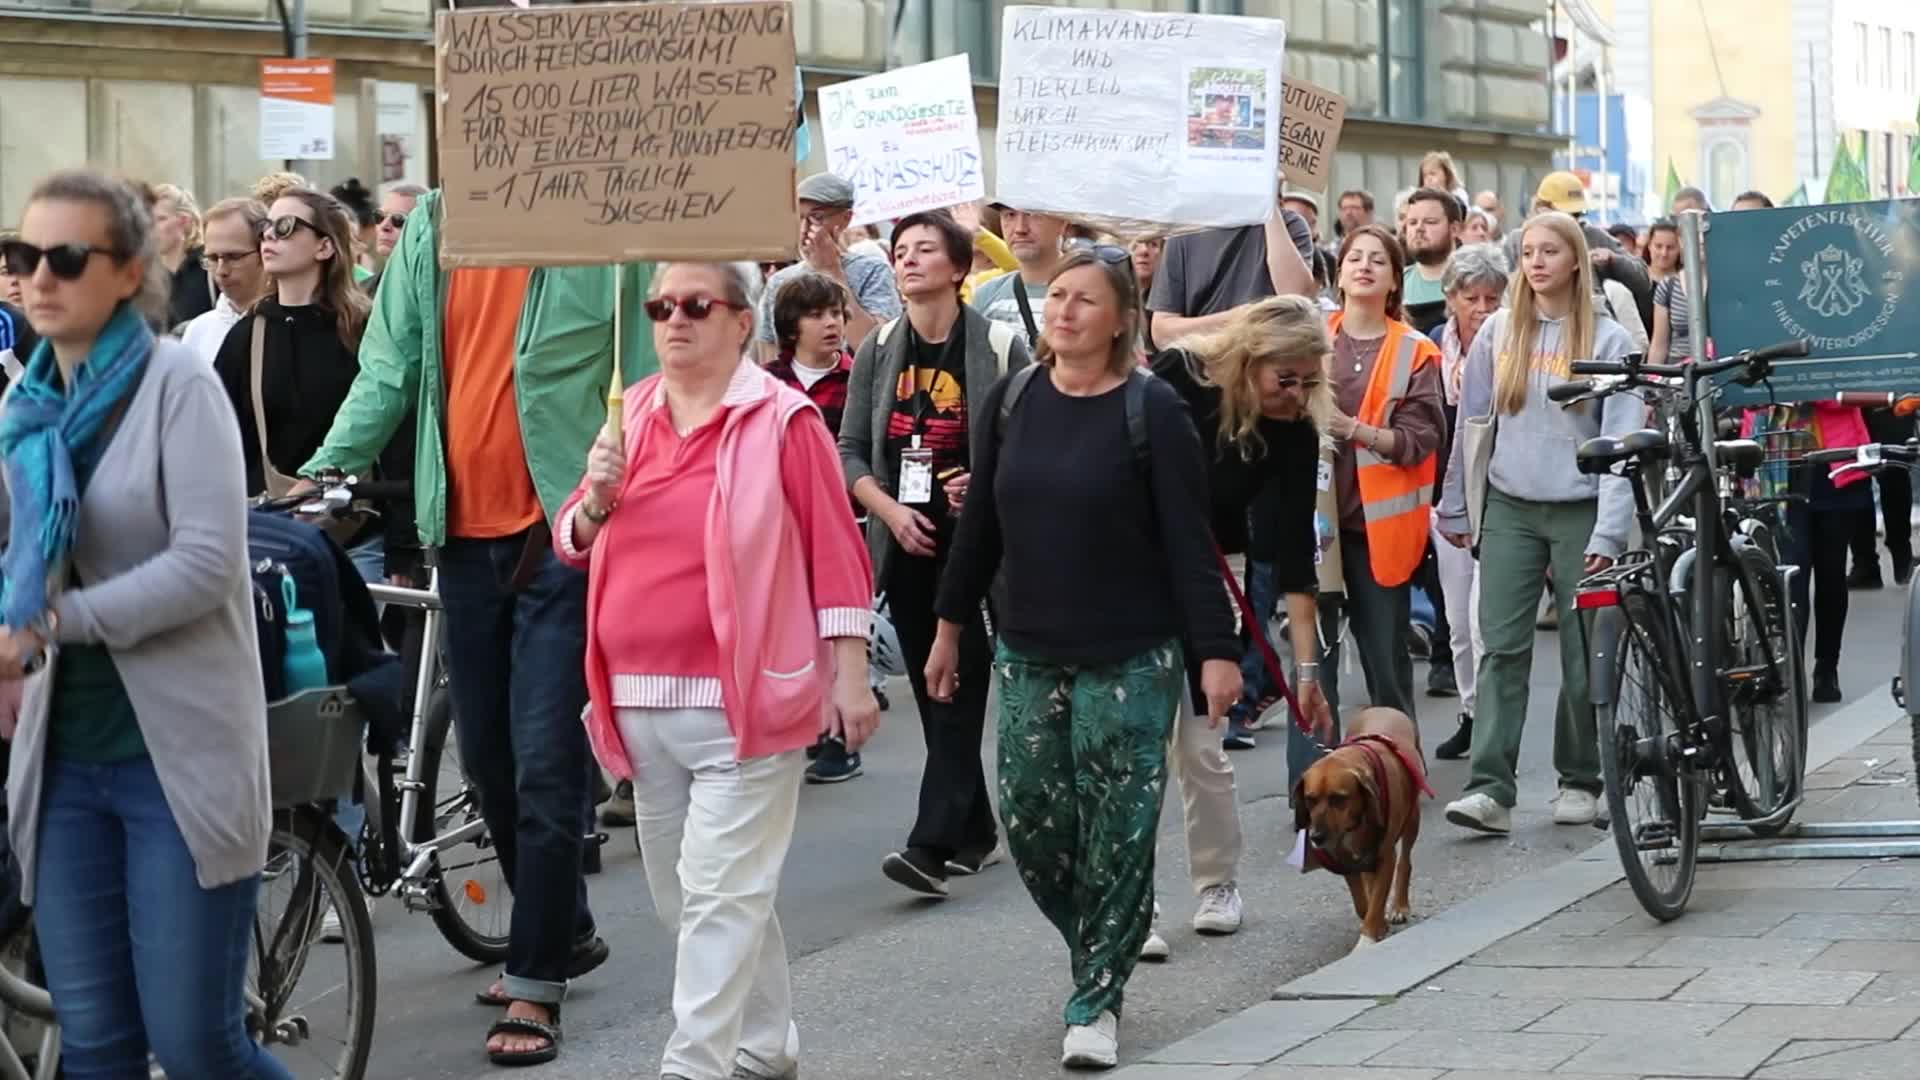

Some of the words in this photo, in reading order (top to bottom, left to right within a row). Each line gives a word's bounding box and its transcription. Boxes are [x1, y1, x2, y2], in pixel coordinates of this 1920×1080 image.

[1013, 15, 1200, 42] KLIMAWANDEL
[448, 46, 529, 75] DURCH
[568, 73, 640, 106] LITER
[653, 66, 777, 100] WASSER
[1013, 74, 1122, 100] TIERLEID
[1280, 115, 1327, 152] EGAN
[473, 141, 520, 171] VON
[533, 134, 619, 164] EINEM
[494, 172, 518, 209] 1
[519, 170, 589, 212] JAHR
[583, 187, 736, 225] DUSCHEN
[1768, 210, 1895, 263] TAPETENFISCHER
[1771, 299, 1809, 342] FINEST
